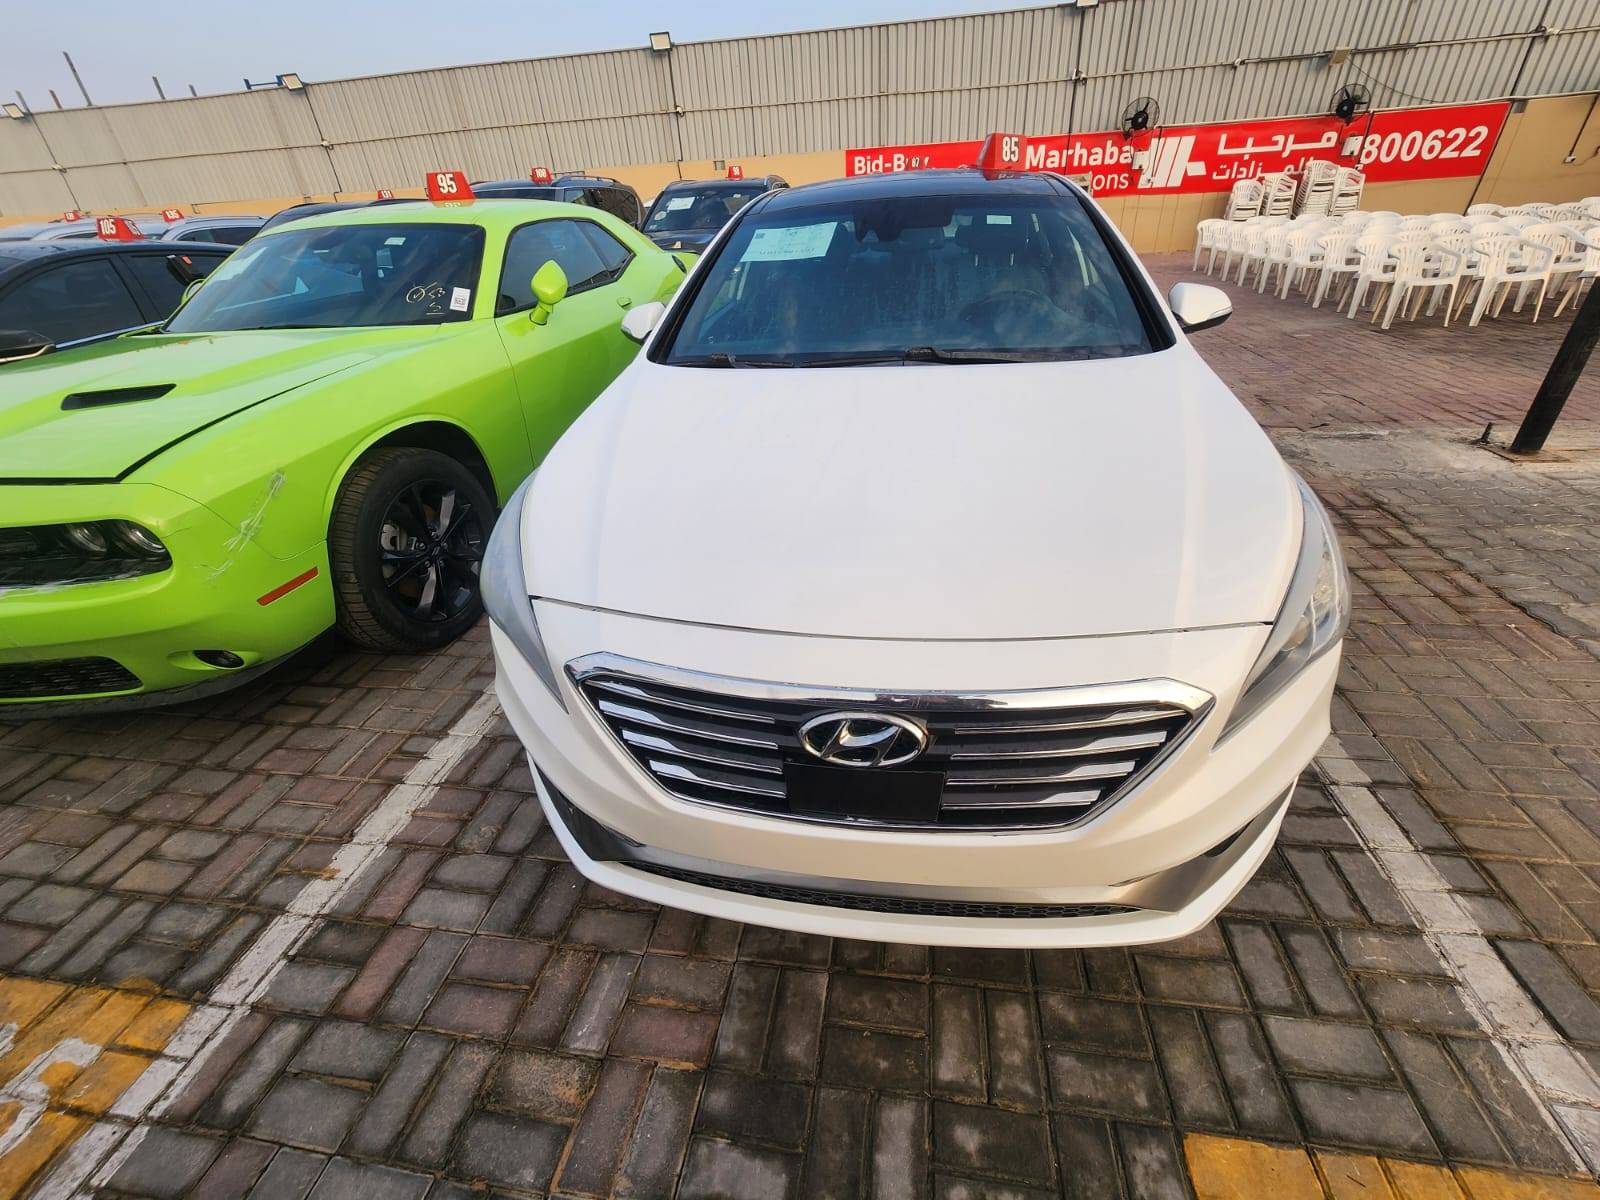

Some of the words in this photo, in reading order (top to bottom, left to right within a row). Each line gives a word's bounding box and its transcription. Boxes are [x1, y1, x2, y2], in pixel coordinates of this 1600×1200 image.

[1002, 136, 1018, 162] 85
[1025, 140, 1134, 169] Marhaba
[1217, 131, 1338, 160] مرحبا
[1360, 126, 1489, 165] 800622
[436, 173, 458, 194] 95
[99, 219, 116, 234] 105
